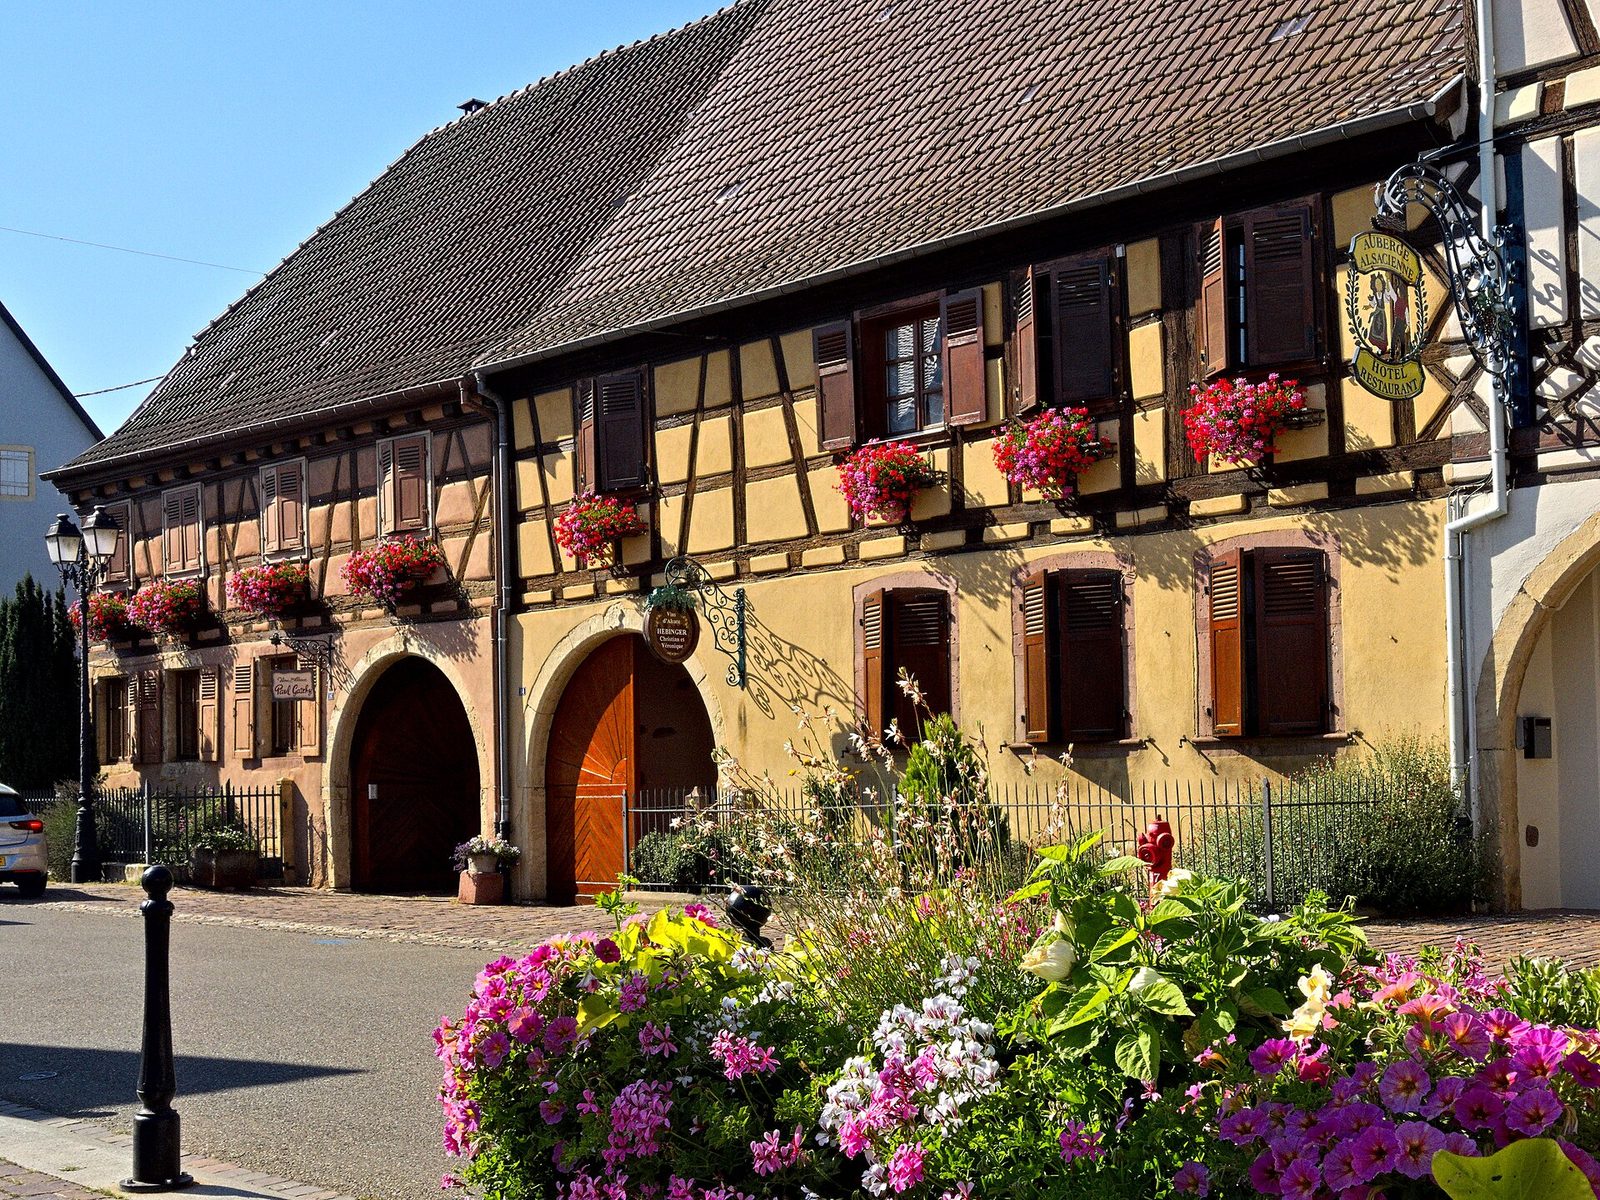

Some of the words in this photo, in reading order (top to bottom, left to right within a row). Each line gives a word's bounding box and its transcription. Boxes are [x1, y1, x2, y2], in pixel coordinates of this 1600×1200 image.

[1363, 235, 1410, 262] AUBERGE
[1360, 252, 1414, 281] ALSACIENNE
[1360, 369, 1418, 396] RESTAURANT
[1371, 360, 1408, 380] HOTEL
[656, 628, 687, 636] HEBINGER
